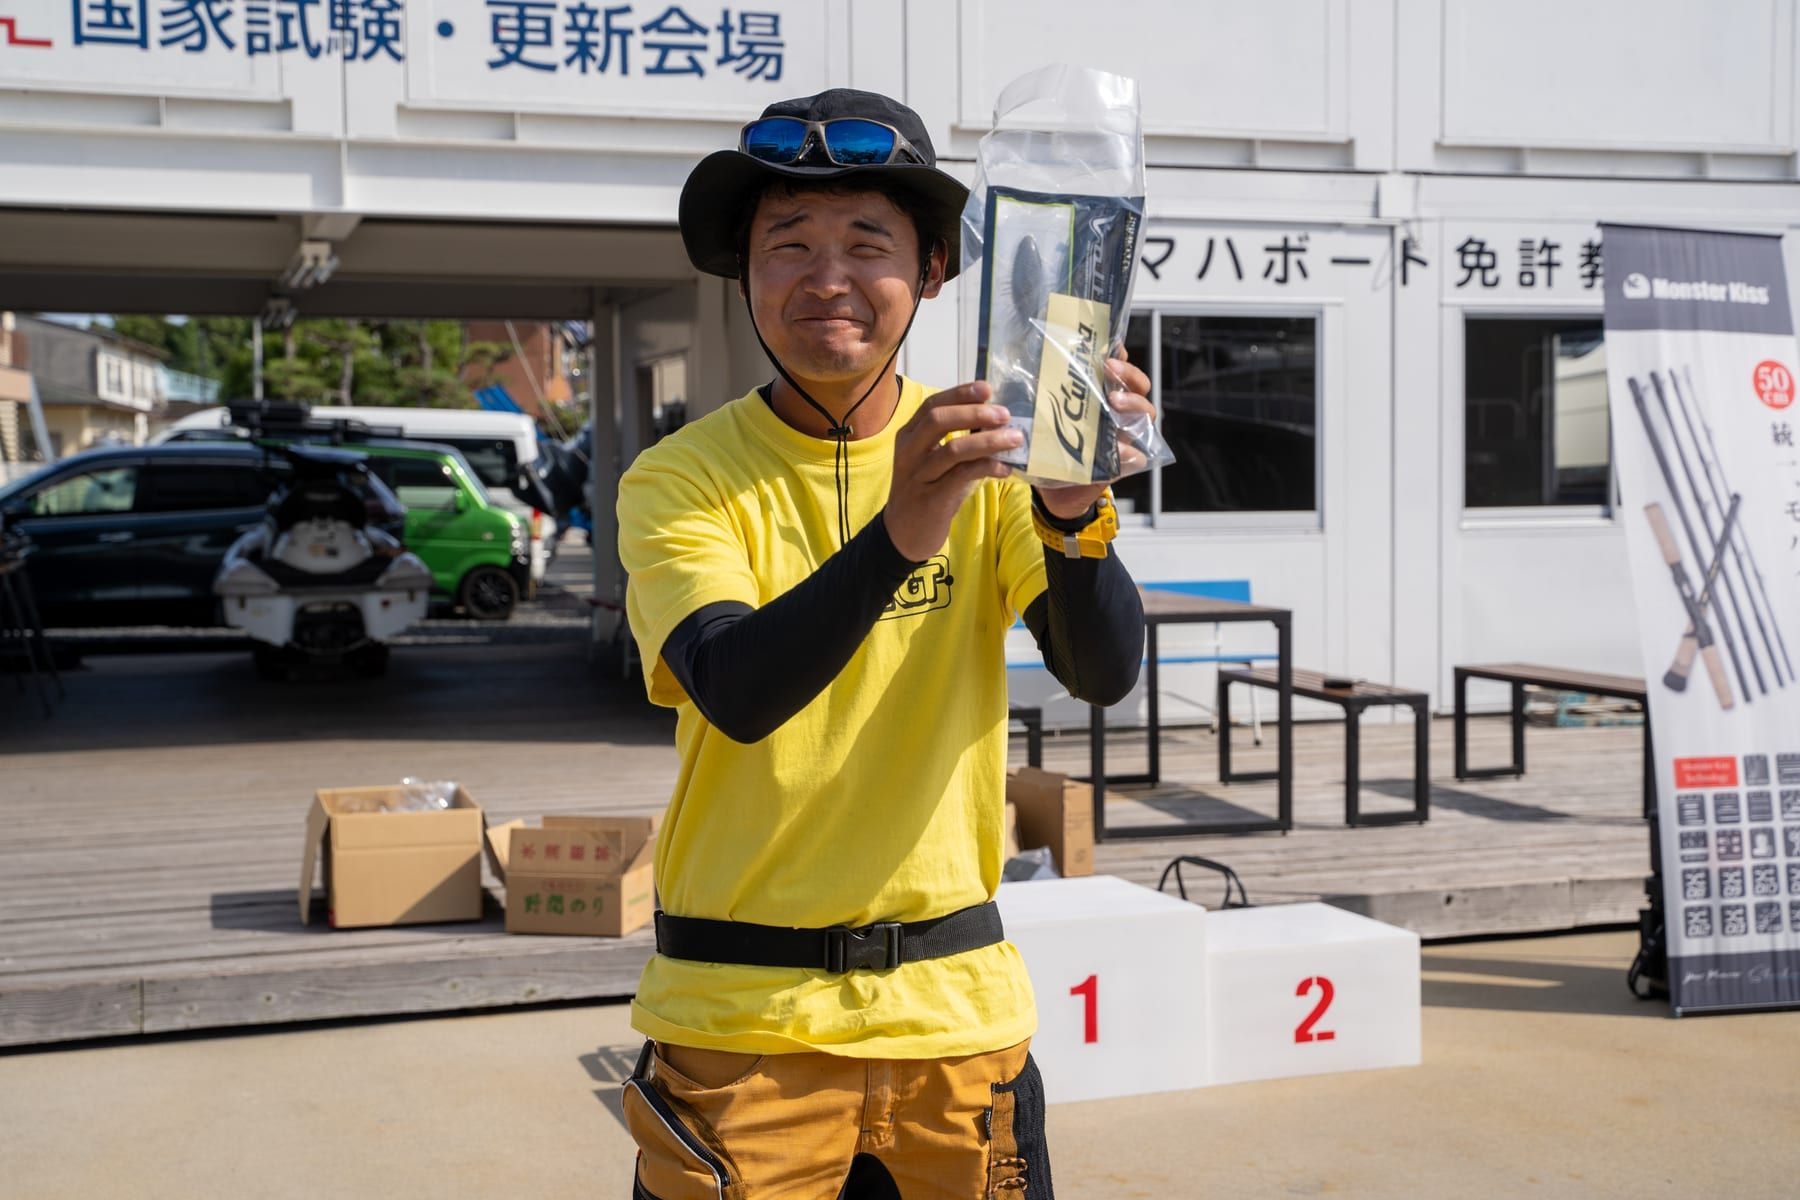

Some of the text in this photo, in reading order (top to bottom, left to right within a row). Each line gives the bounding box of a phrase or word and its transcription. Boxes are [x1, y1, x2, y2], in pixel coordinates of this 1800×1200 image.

[1652, 277, 1770, 305] Monster Kiss
[1758, 366, 1789, 392] 50
[1070, 975, 1098, 1044] 1
[1294, 976, 1335, 1044] 2
